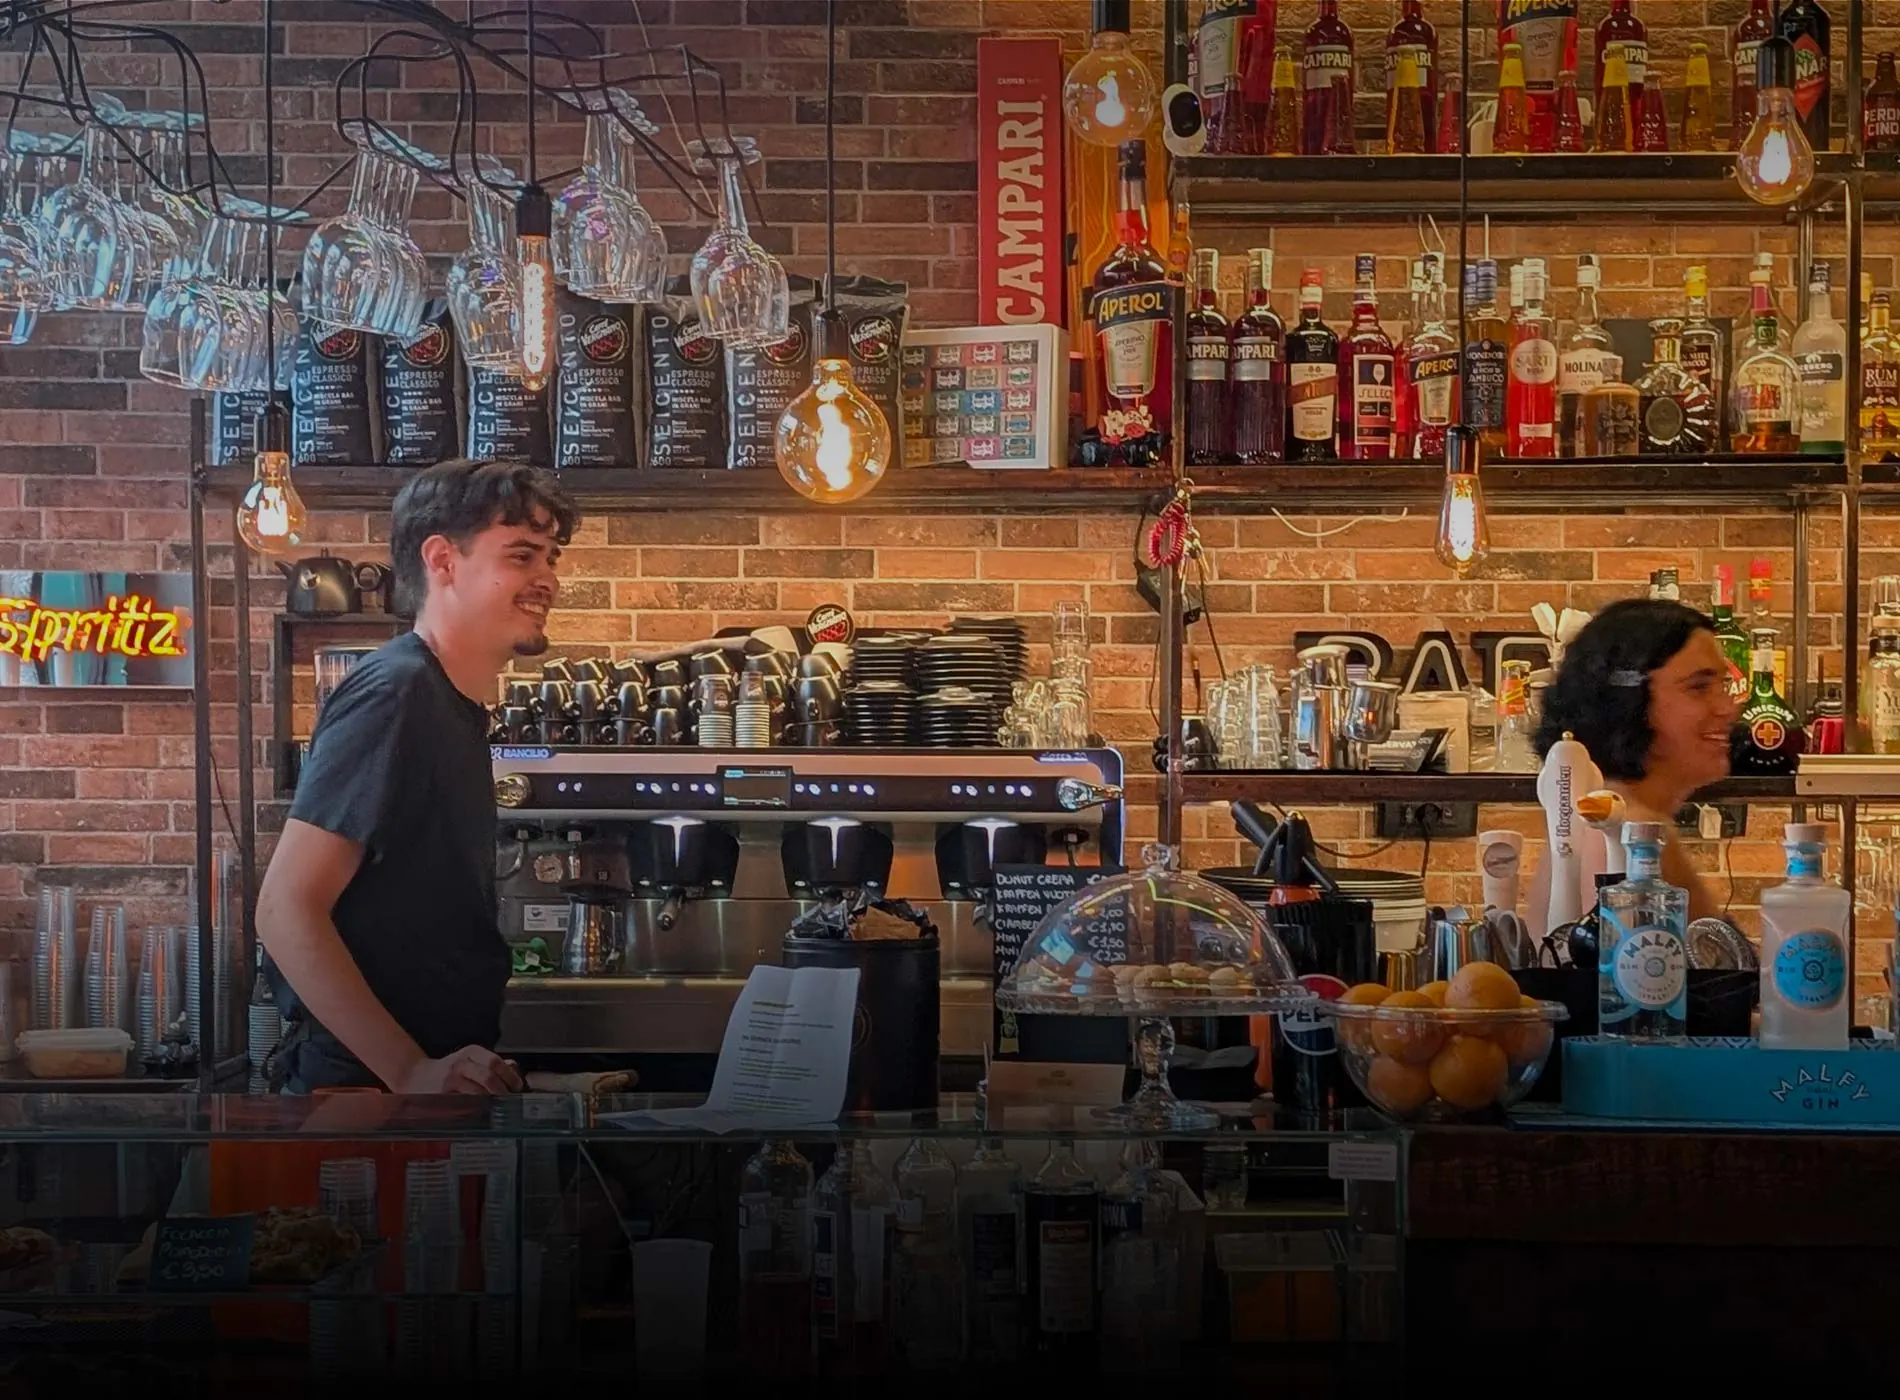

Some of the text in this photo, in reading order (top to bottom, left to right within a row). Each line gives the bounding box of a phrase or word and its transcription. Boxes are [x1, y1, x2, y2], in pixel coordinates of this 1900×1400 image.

[1304, 52, 1352, 68] CAMPARI
[1795, 56, 1828, 80] NAR
[996, 99, 1046, 325] CAMPARI
[1099, 292, 1165, 324] APEROL
[1234, 344, 1276, 359] AMPARI
[578, 368, 624, 377] ESPRESSO
[852, 366, 891, 375] SPRESSO
[1565, 361, 1603, 374] MOLINA
[400, 371, 445, 380] ESPRESSO
[579, 377, 620, 386] CLASSICO
[1865, 368, 1898, 382] RUM
[400, 379, 440, 389] CLASSICO
[651, 315, 672, 456] SEICENTO
[671, 378, 711, 387] CLASSICO
[562, 455, 581, 466] 600
[1742, 704, 1795, 723] UNICUM
[503, 748, 549, 759] RANCILIO
[1623, 933, 1682, 958] MALFY
[1769, 1063, 1871, 1103] MALFY
[1801, 1097, 1840, 1110] GIN
